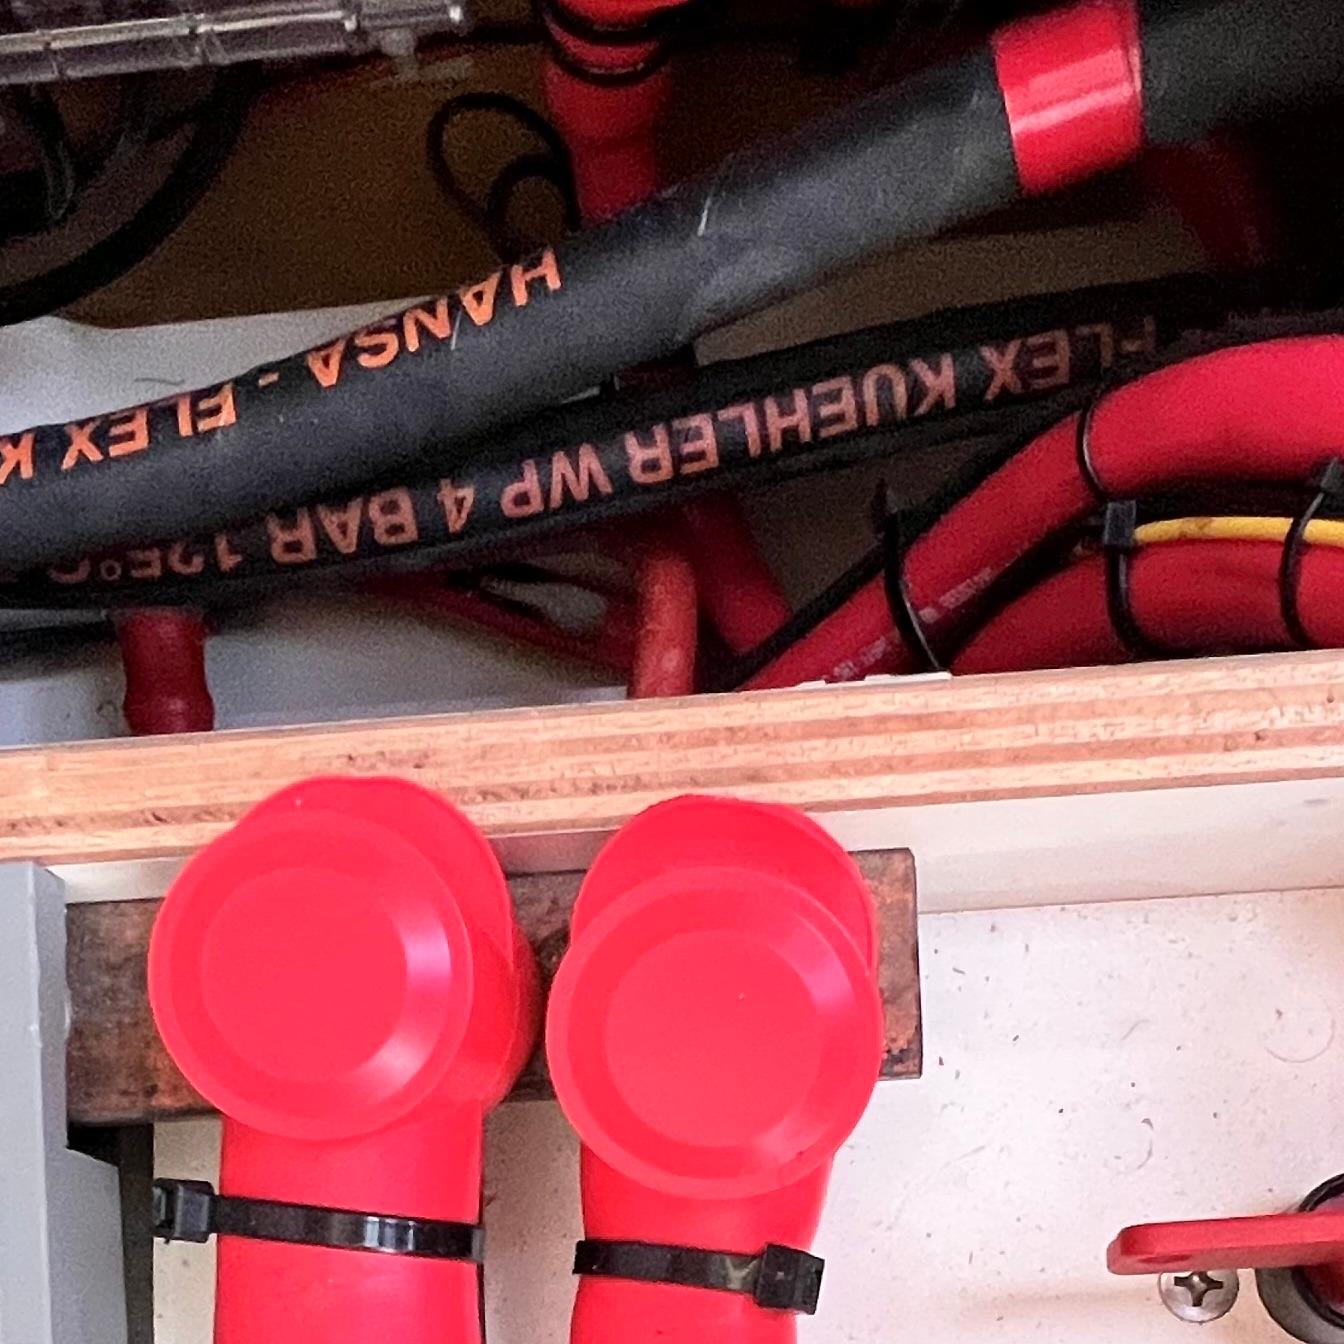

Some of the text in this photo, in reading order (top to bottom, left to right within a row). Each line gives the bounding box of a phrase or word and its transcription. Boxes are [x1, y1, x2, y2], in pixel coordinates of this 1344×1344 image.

[306, 246, 563, 389] HANSA
[981, 316, 1157, 396] FLEX
[60, 383, 240, 470] FLEX
[623, 350, 958, 486] KUEHLER
[436, 480, 477, 531] 4
[501, 450, 612, 517] WP
[266, 487, 421, 565] BAR
